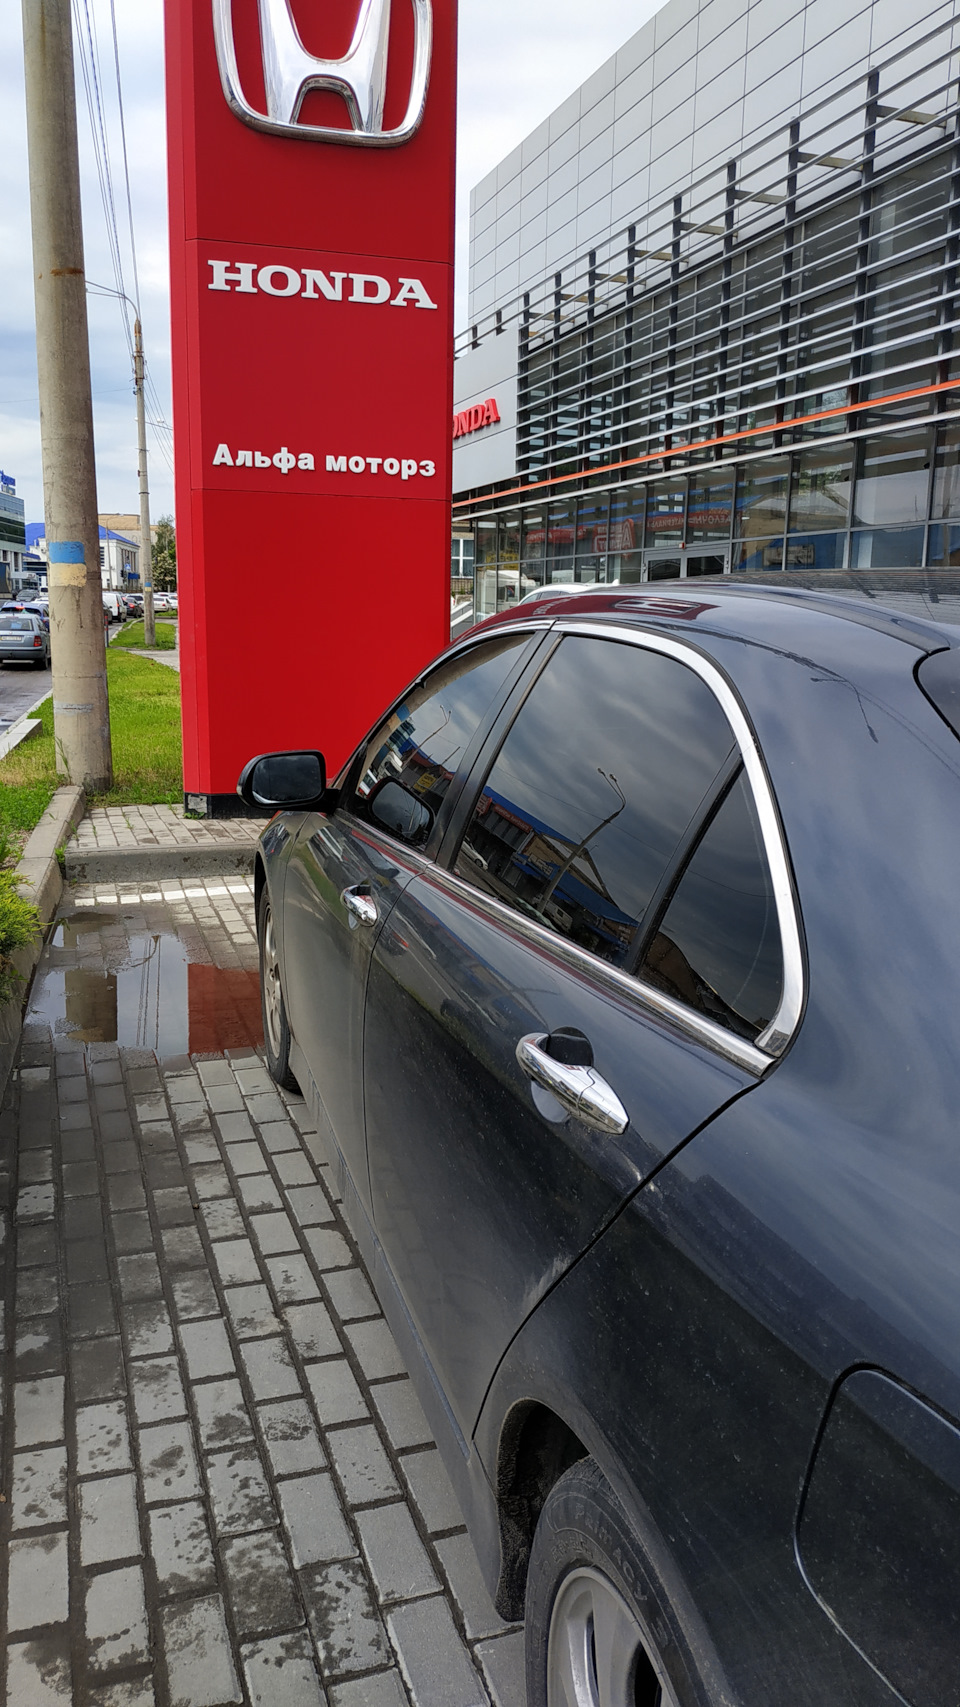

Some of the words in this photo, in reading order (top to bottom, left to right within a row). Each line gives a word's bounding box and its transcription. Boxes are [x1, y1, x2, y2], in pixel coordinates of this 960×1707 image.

[207, 259, 438, 310] HONDA
[212, 443, 315, 474] Альфа
[325, 454, 437, 481] моторз
